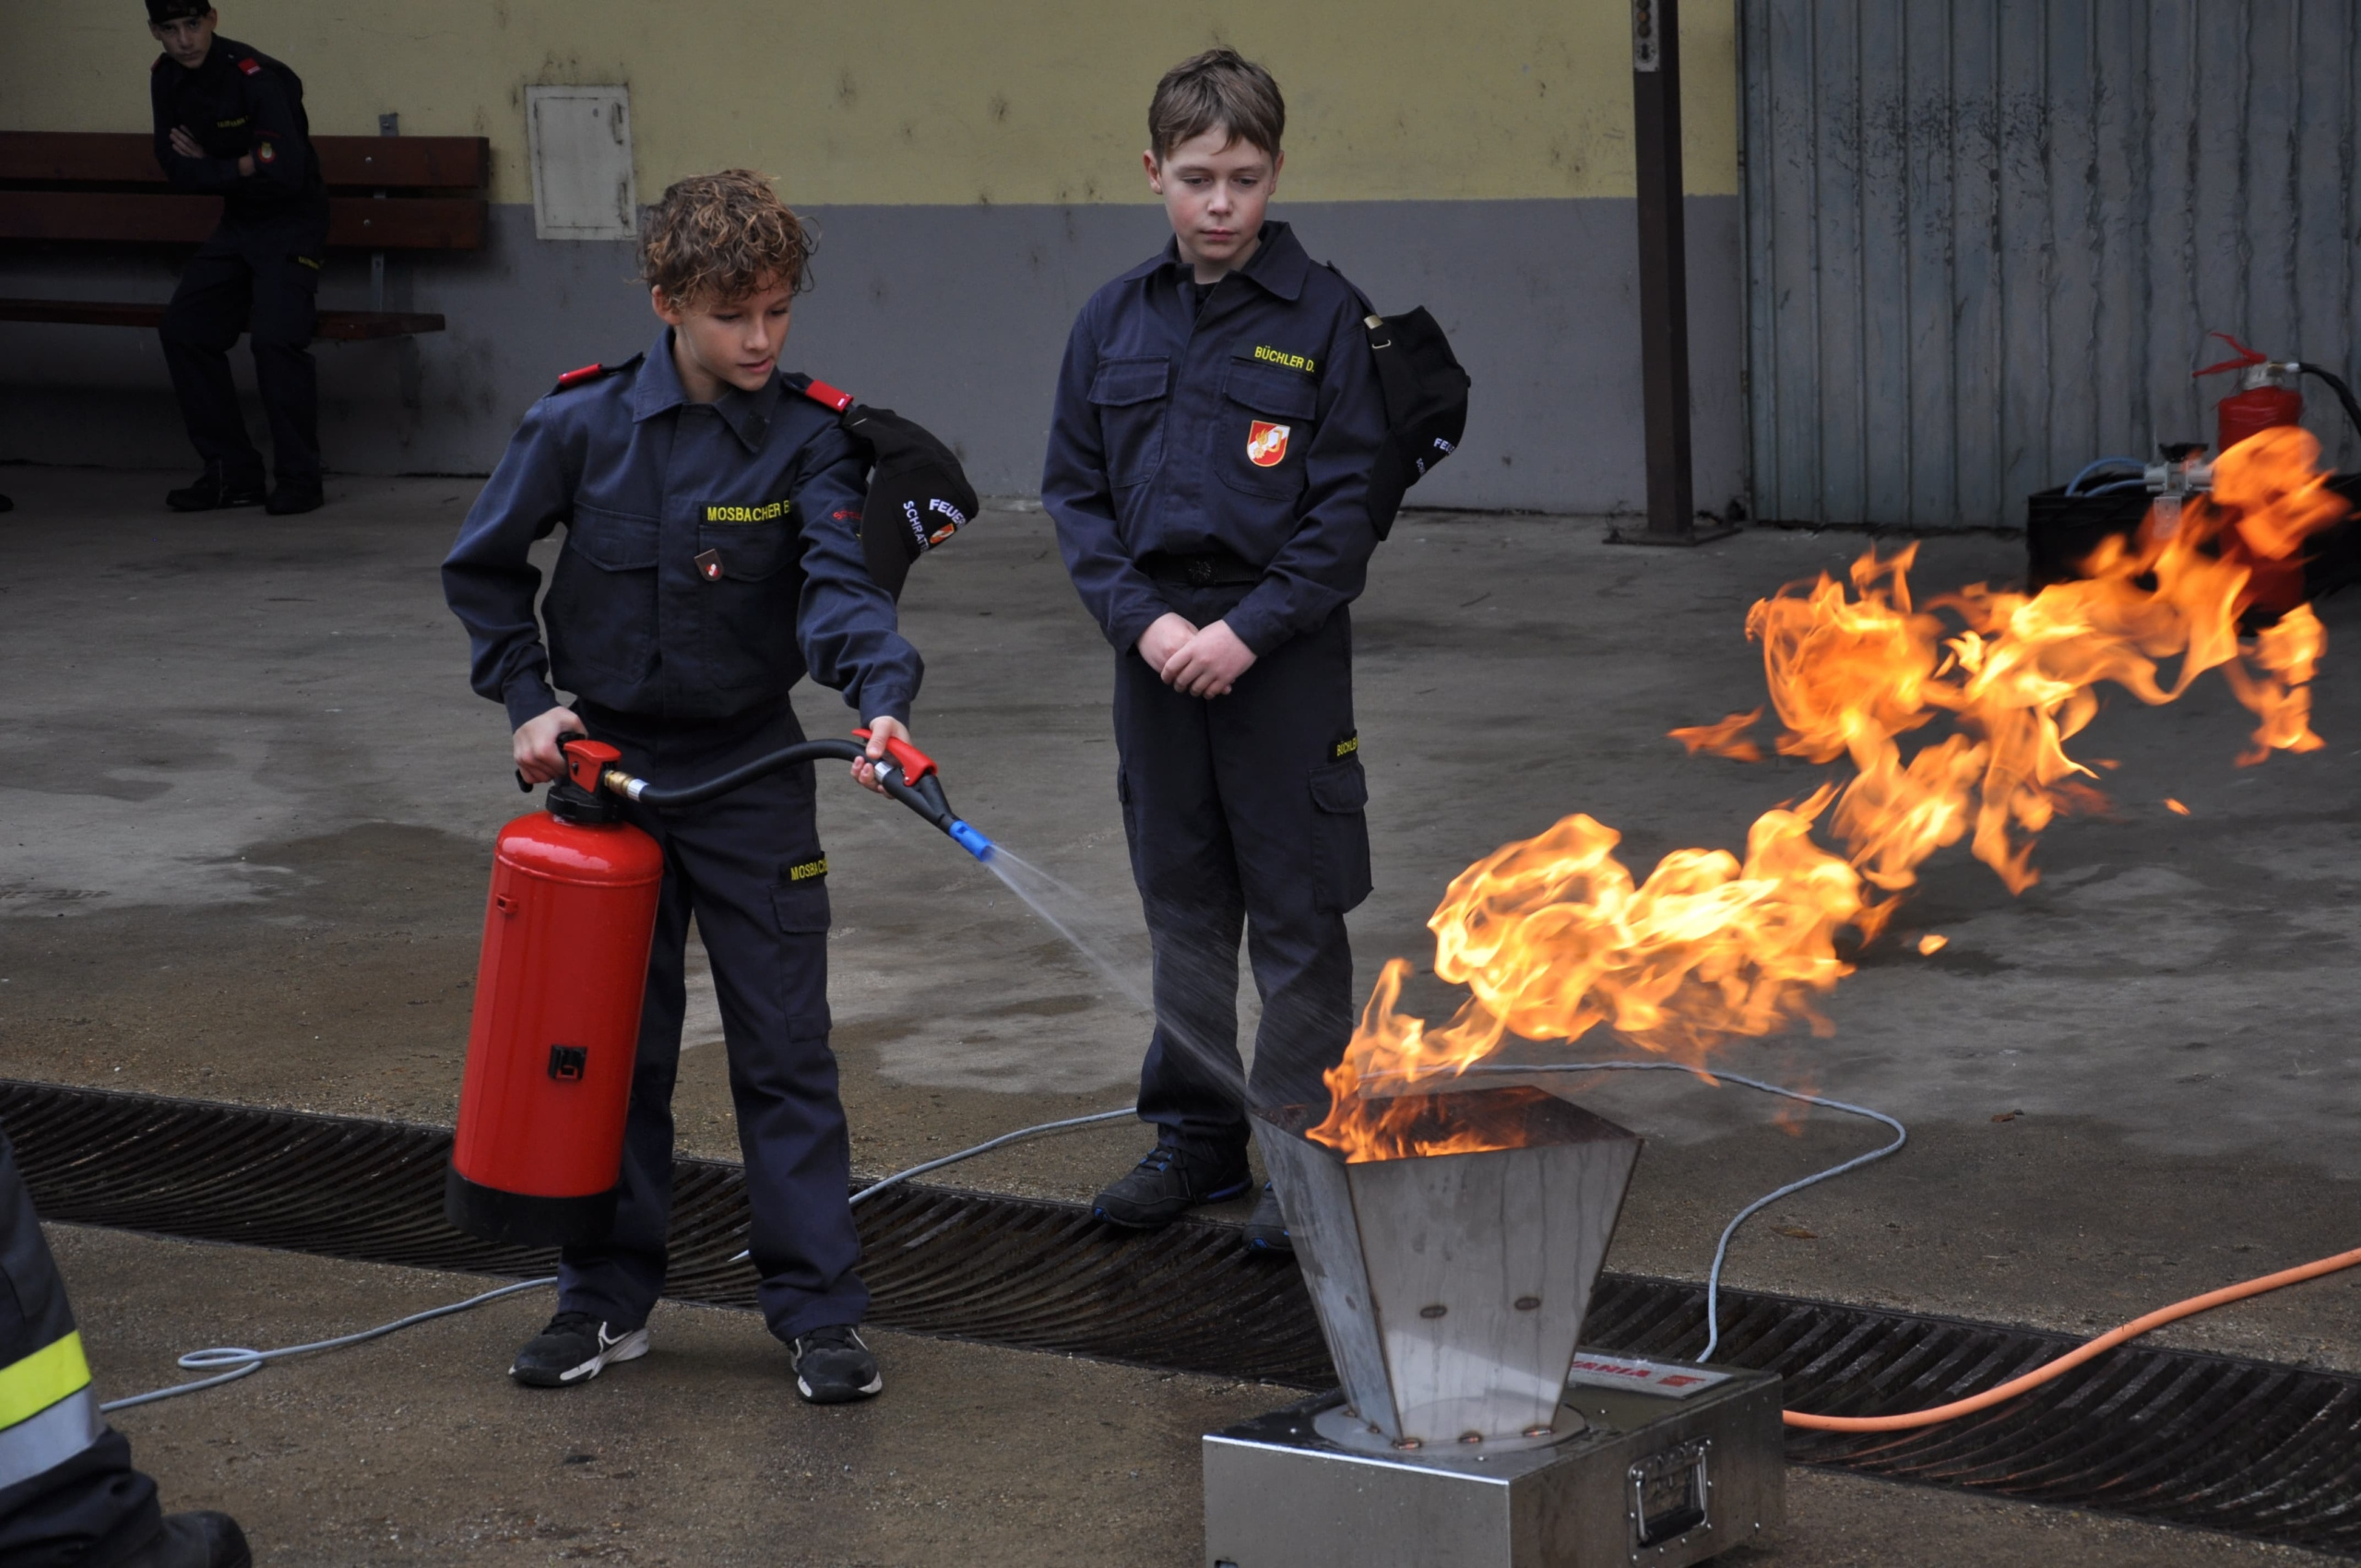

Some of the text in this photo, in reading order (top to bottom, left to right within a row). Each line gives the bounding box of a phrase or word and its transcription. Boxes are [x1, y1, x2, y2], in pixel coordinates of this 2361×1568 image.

[1254, 345, 1315, 373] BÜCHLER D.
[707, 503, 781, 522] MOSBACHER
